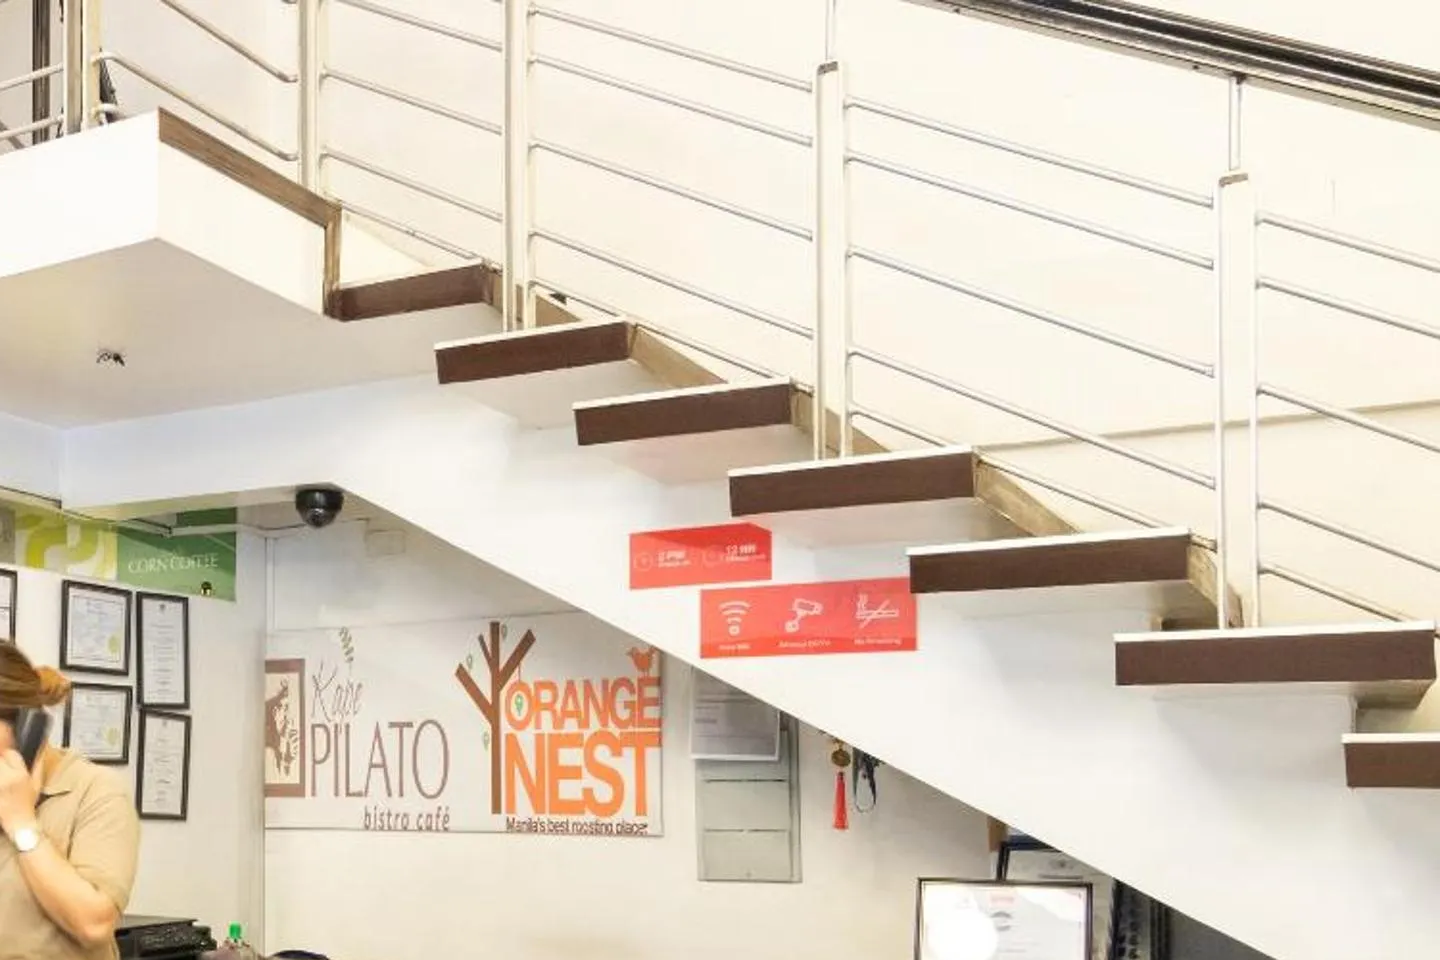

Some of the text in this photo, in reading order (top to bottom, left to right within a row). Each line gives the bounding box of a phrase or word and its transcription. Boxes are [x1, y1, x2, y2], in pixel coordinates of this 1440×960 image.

[504, 676, 662, 732] ORANGE
[311, 719, 450, 800] PILATO
[504, 729, 662, 817] NEST
[363, 804, 451, 832] bistro café
[506, 816, 546, 834] Manila's
[549, 818, 570, 834] best
